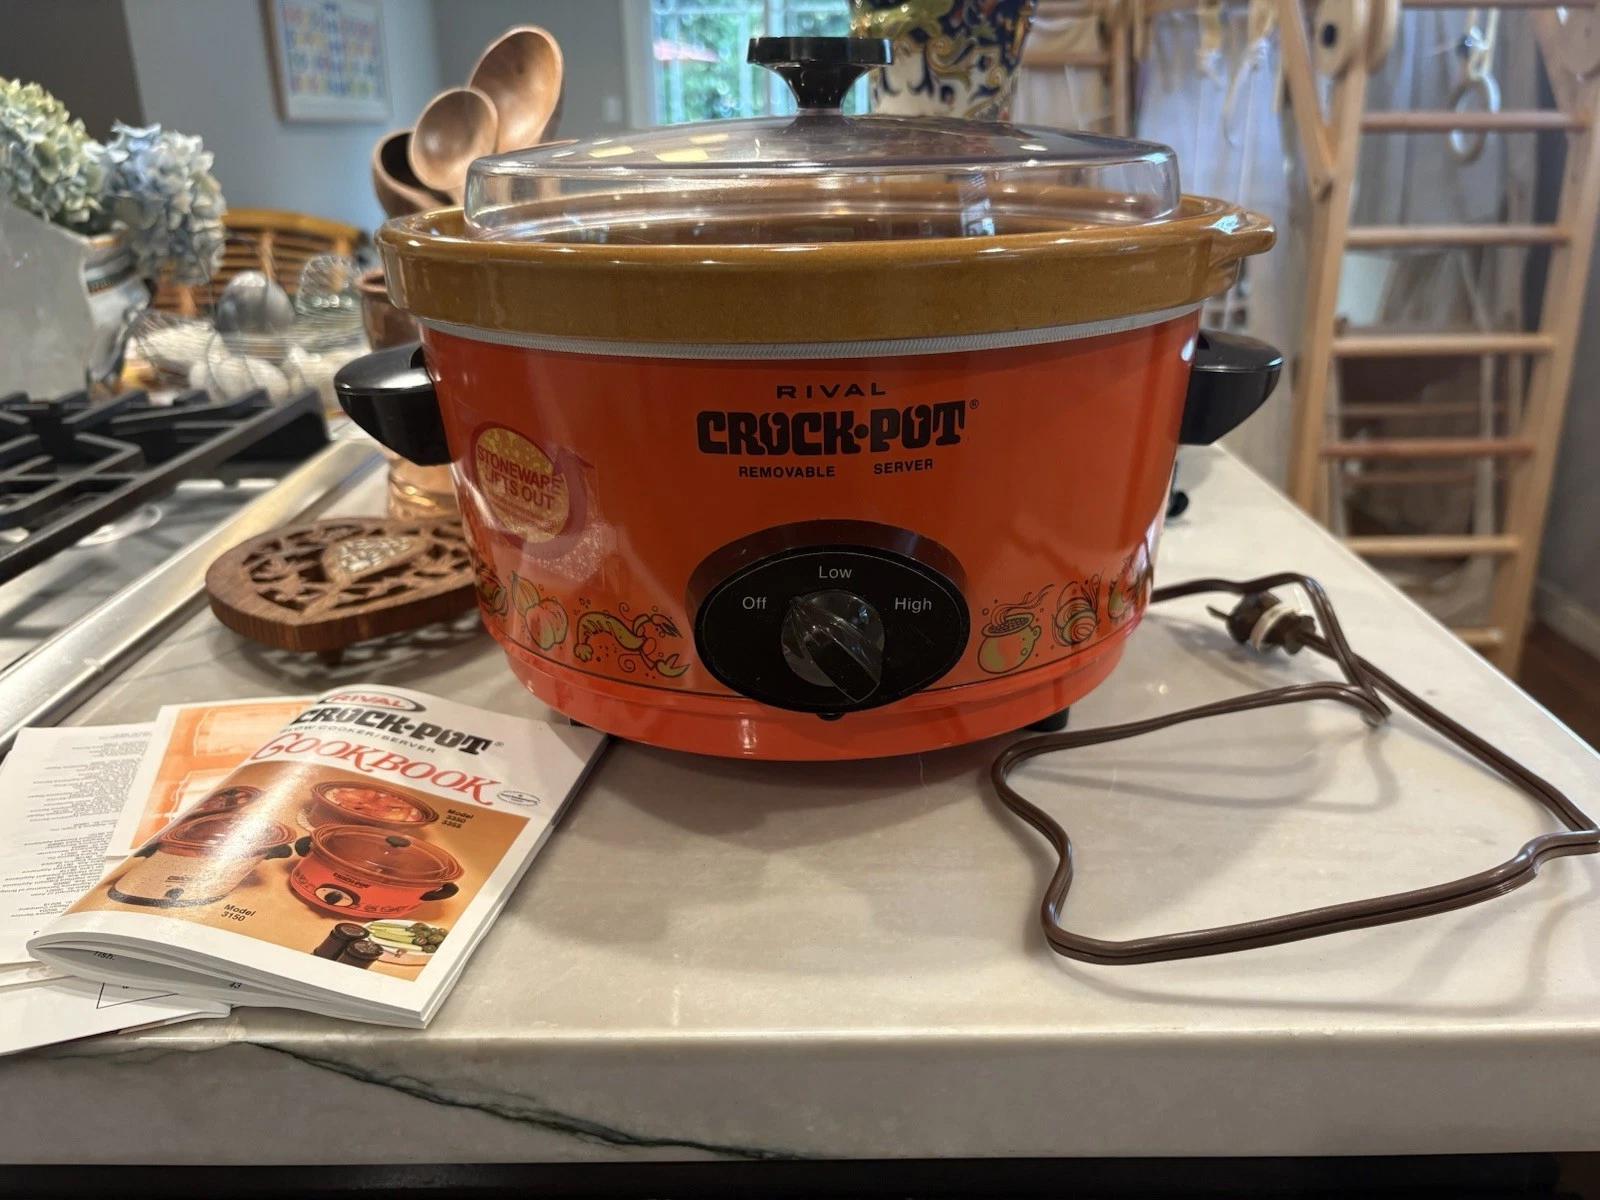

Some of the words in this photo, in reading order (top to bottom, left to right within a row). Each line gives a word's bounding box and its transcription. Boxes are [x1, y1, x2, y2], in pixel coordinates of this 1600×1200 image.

[776, 382, 886, 399] RIVAL
[477, 445, 564, 495] STONEWARE
[738, 466, 835, 478] REMOVABLE
[873, 458, 933, 475] SERVER
[485, 469, 519, 497] LIFTS
[521, 485, 556, 510] OUT
[819, 565, 852, 579] Low
[742, 595, 767, 610] Off
[894, 597, 932, 615] High
[330, 692, 409, 709] RIVAL
[318, 725, 436, 753] COOKER/SERVER
[250, 732, 502, 806] COOKBOOK
[447, 809, 474, 819] Model
[221, 911, 246, 922] 3150
[223, 904, 256, 917] Model
